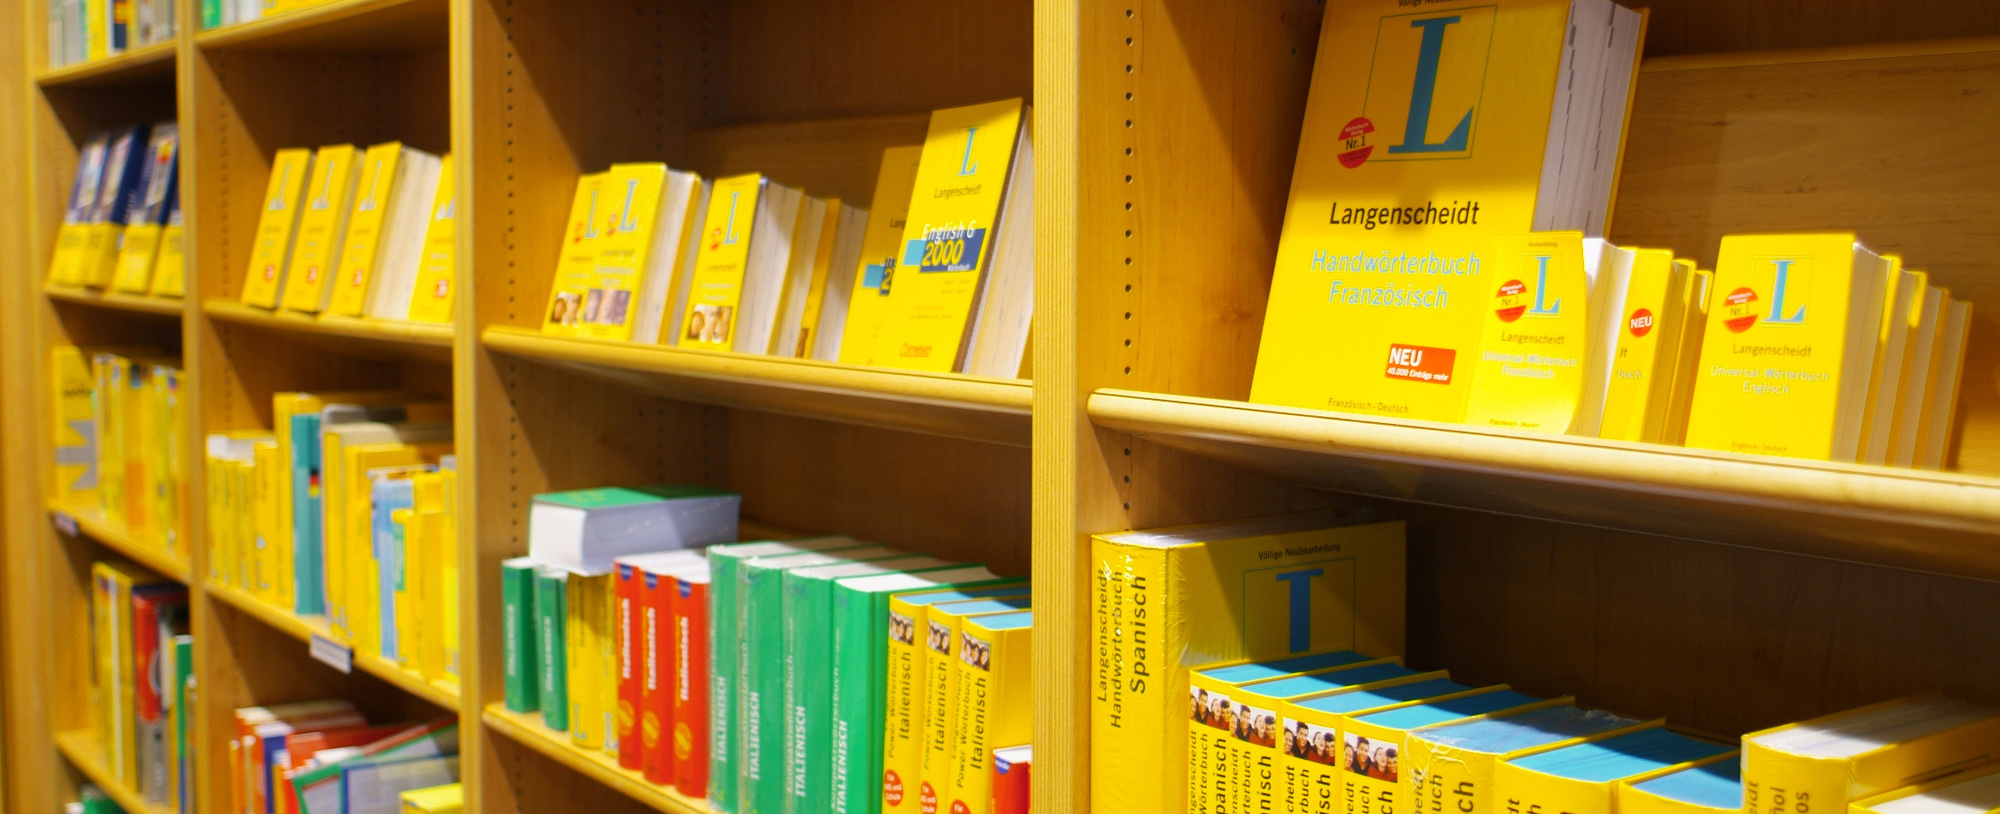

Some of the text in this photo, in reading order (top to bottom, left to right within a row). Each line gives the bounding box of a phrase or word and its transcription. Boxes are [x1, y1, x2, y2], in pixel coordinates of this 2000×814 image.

[1388, 15, 1474, 154] L
[958, 128, 979, 176] L
[1345, 138, 1359, 150] Nr.
[934, 184, 982, 200] Langenscheidt
[1329, 201, 1480, 230] Langenscheidt
[921, 220, 976, 245] English 6
[922, 239, 965, 267] 2000
[1311, 249, 1481, 275] Handwörterbuch
[1528, 255, 1561, 314] L
[1328, 280, 1448, 307] Französisch
[1730, 306, 1744, 317] Nr.
[1762, 259, 1805, 324] L
[1501, 331, 1565, 346] Langenscheidt
[1630, 316, 1653, 330] NEU
[1389, 347, 1423, 367] NEU
[1481, 350, 1577, 367] Universal-Wörterbuch
[1501, 365, 1555, 379] Französisch
[1710, 365, 1829, 381] Universal-Wörterbuch
[1732, 343, 1812, 357] Langenscheidt
[1327, 398, 1372, 410] Französisch
[1377, 402, 1409, 414] Deutsch
[1742, 381, 1790, 395] Englisch
[1258, 543, 1341, 560] Völlige Neubearbeitung
[647, 607, 657, 690] Italienisch
[680, 616, 690, 701] Italienisch
[1097, 569, 1108, 702] Langenscheidt
[1111, 571, 1122, 728] Handwörterbuch
[1130, 576, 1150, 694] Spanisch
[889, 647, 898, 718] Wörterbuch
[899, 651, 911, 740] Italienisch
[925, 657, 934, 729] Wörterbuch
[934, 661, 947, 752] Italienisch
[717, 676, 726, 762] ITALIENISCH
[750, 691, 760, 780] ITALIENISCH
[956, 672, 971, 789] Power Wörterbuch
[970, 677, 986, 770] Italienisch
[795, 706, 805, 797] ITALIENISCH
[837, 720, 847, 814] ITALIENISCH
[1257, 755, 1271, 814] nisch
[1284, 765, 1294, 814] cheidt
[1344, 781, 1354, 814] eidt
[1453, 781, 1474, 813] ch
